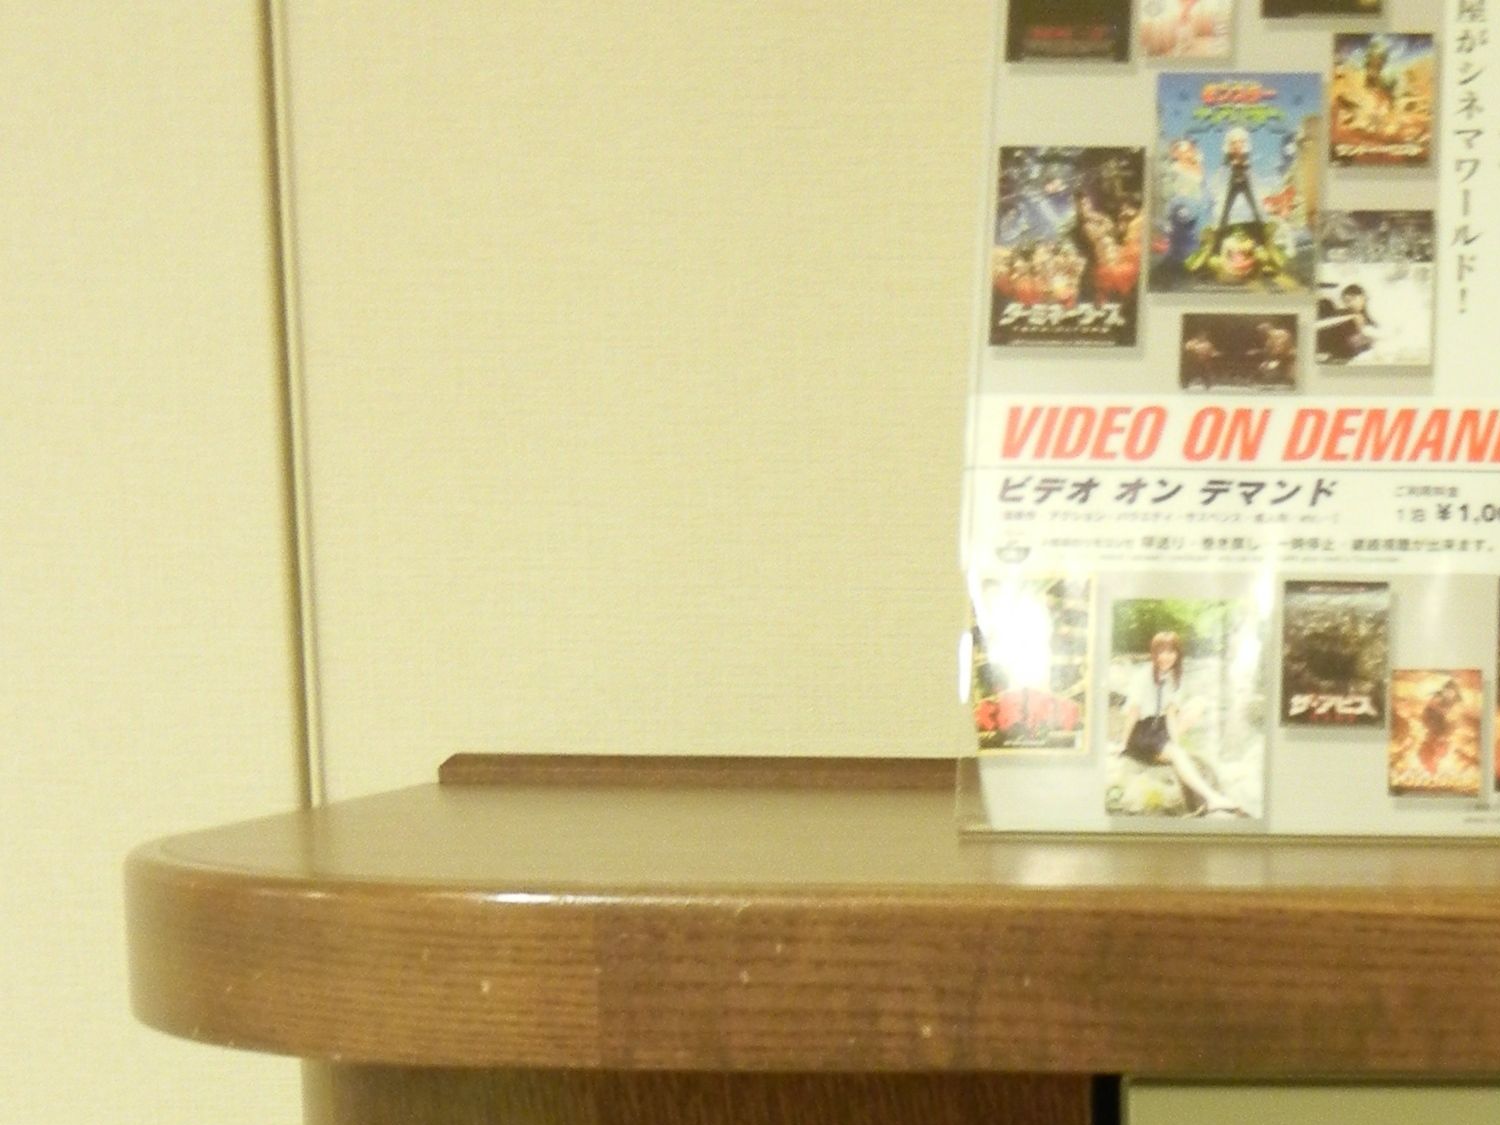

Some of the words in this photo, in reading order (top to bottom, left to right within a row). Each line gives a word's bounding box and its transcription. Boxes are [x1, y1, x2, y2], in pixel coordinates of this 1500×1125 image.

[1000, 405, 1168, 461] VIDEO
[1182, 406, 1272, 463] ON
[998, 475, 1101, 505] ビデオ
[1114, 477, 1183, 505] オン
[1199, 478, 1340, 507] デマンド
